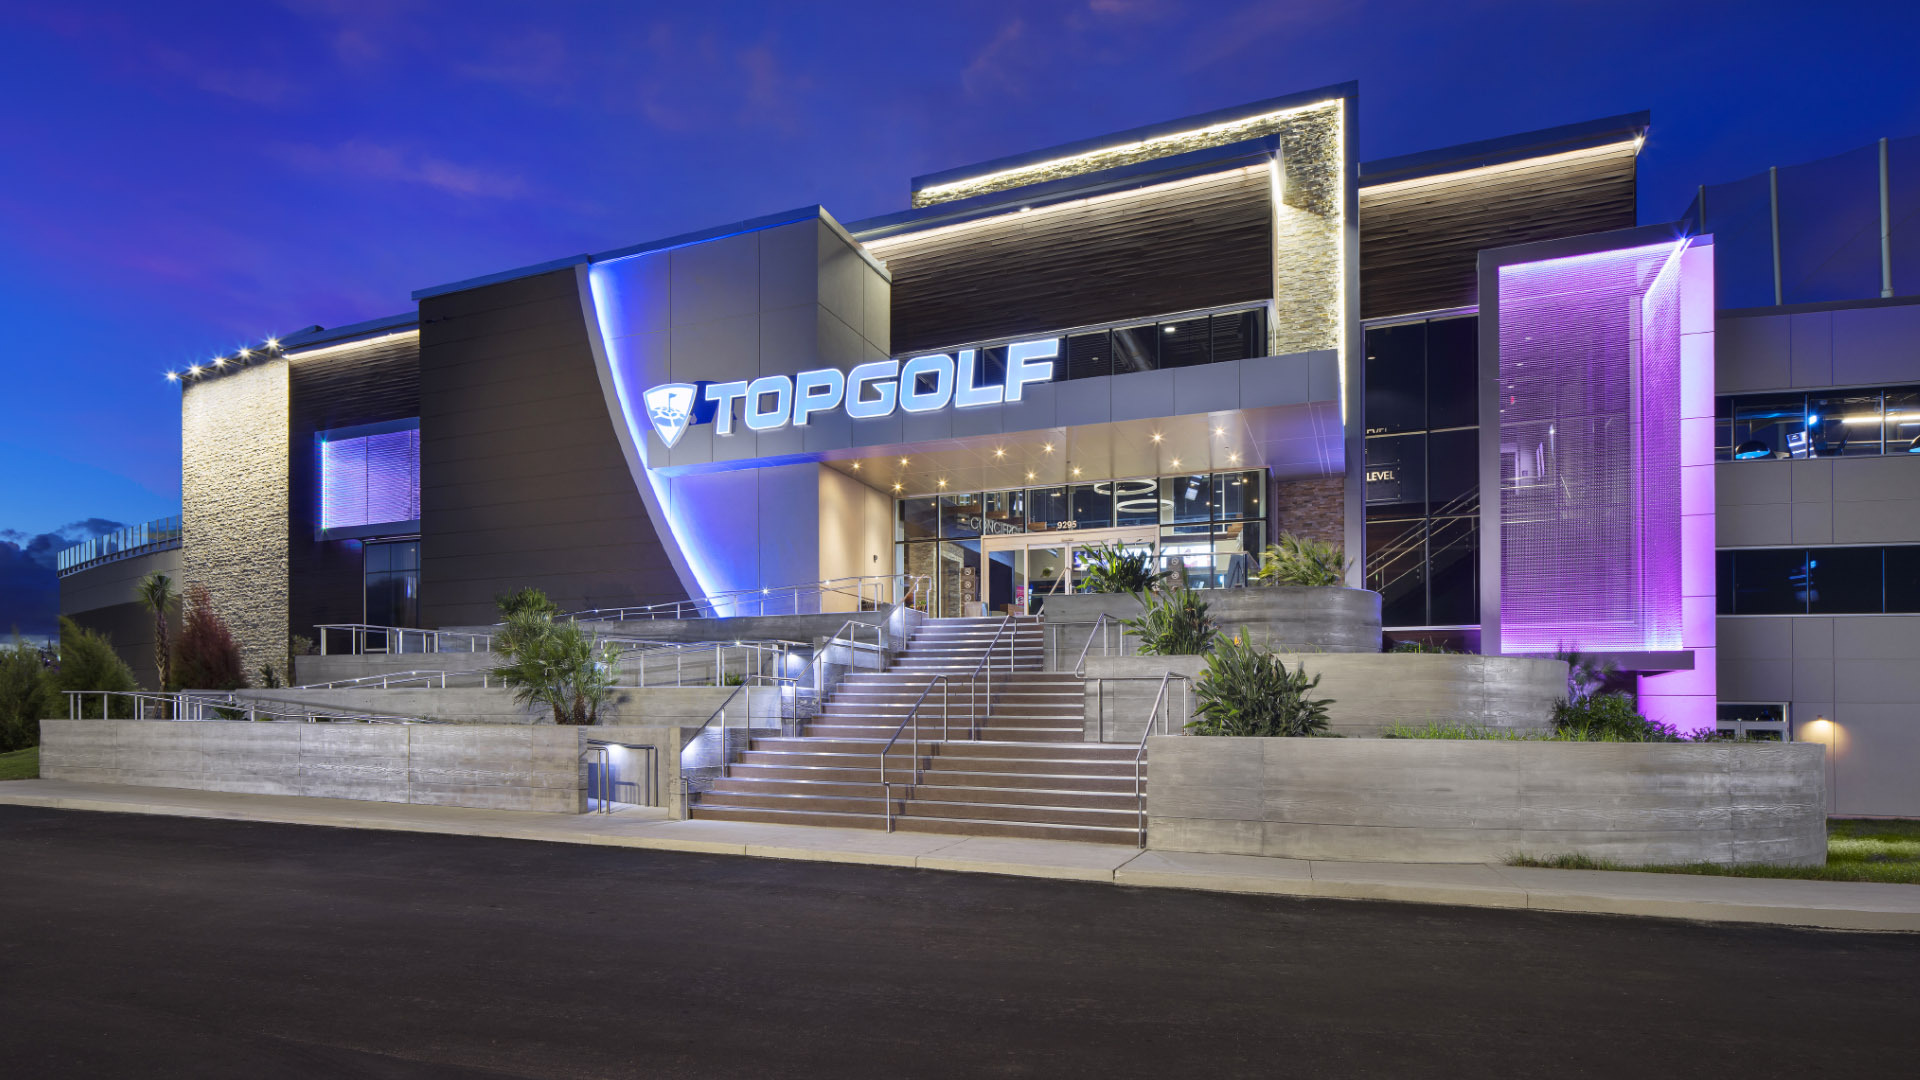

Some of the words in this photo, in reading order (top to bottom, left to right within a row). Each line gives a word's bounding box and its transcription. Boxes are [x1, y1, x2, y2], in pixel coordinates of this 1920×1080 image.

[705, 338, 1059, 435] TOPGOLF
[1366, 470, 1395, 482] LEVEL
[1057, 520, 1077, 529] 9295
